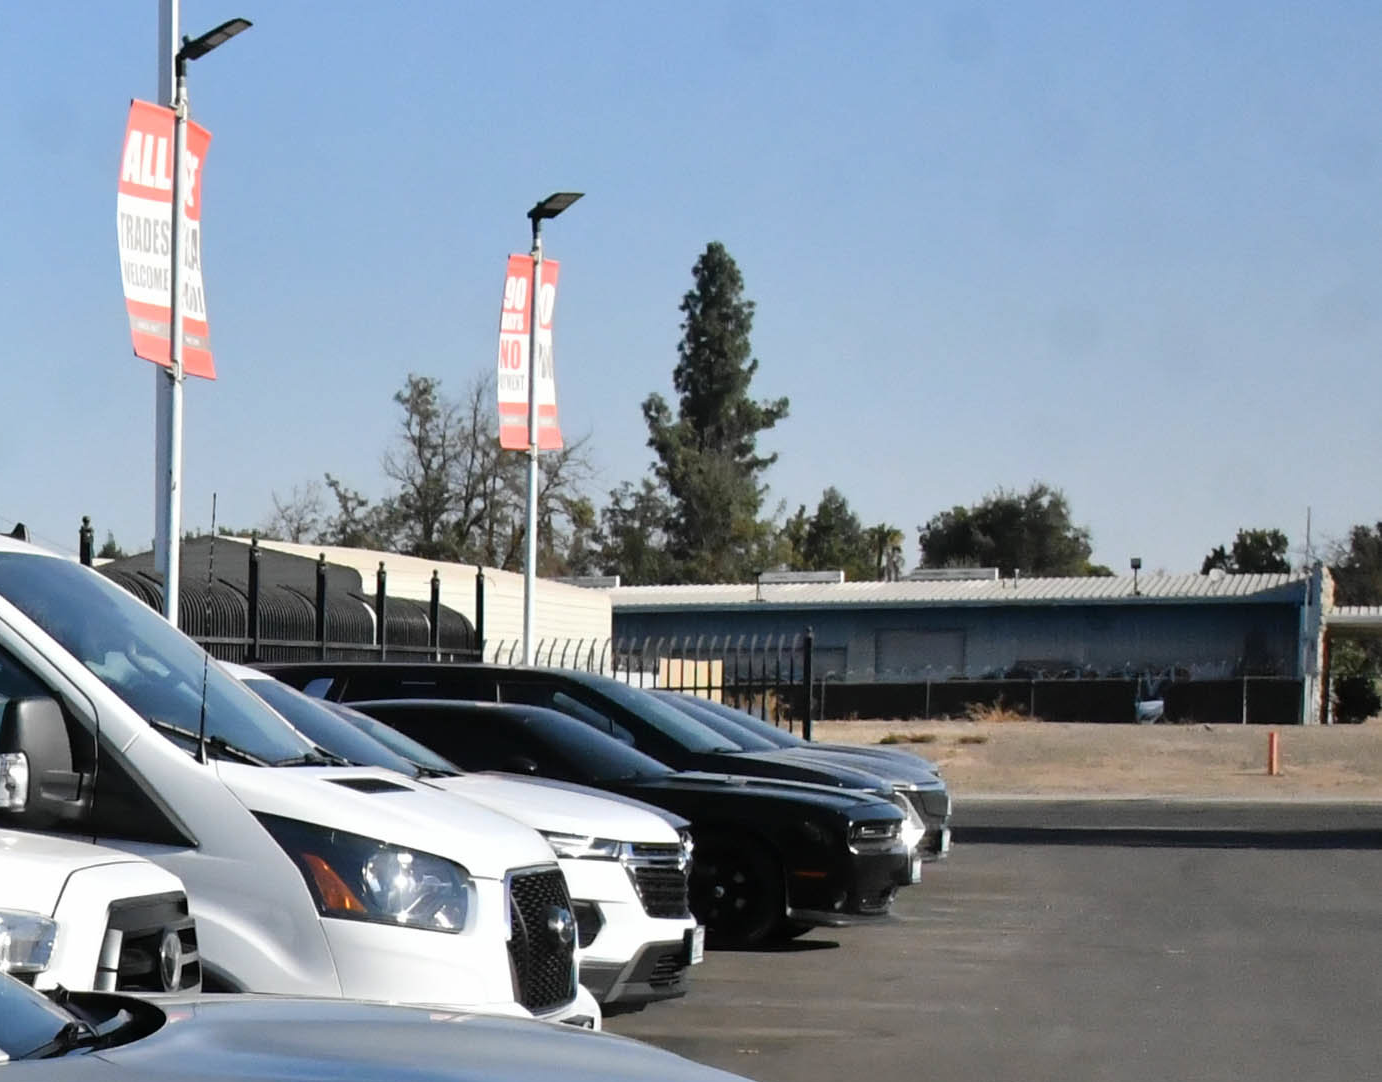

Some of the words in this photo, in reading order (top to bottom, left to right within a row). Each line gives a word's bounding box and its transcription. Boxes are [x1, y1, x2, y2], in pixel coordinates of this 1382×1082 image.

[122, 130, 172, 190] ALL
[120, 212, 172, 256] TRADES
[124, 260, 170, 291] WELCOME
[503, 277, 526, 310] 90
[500, 340, 522, 370] NO
